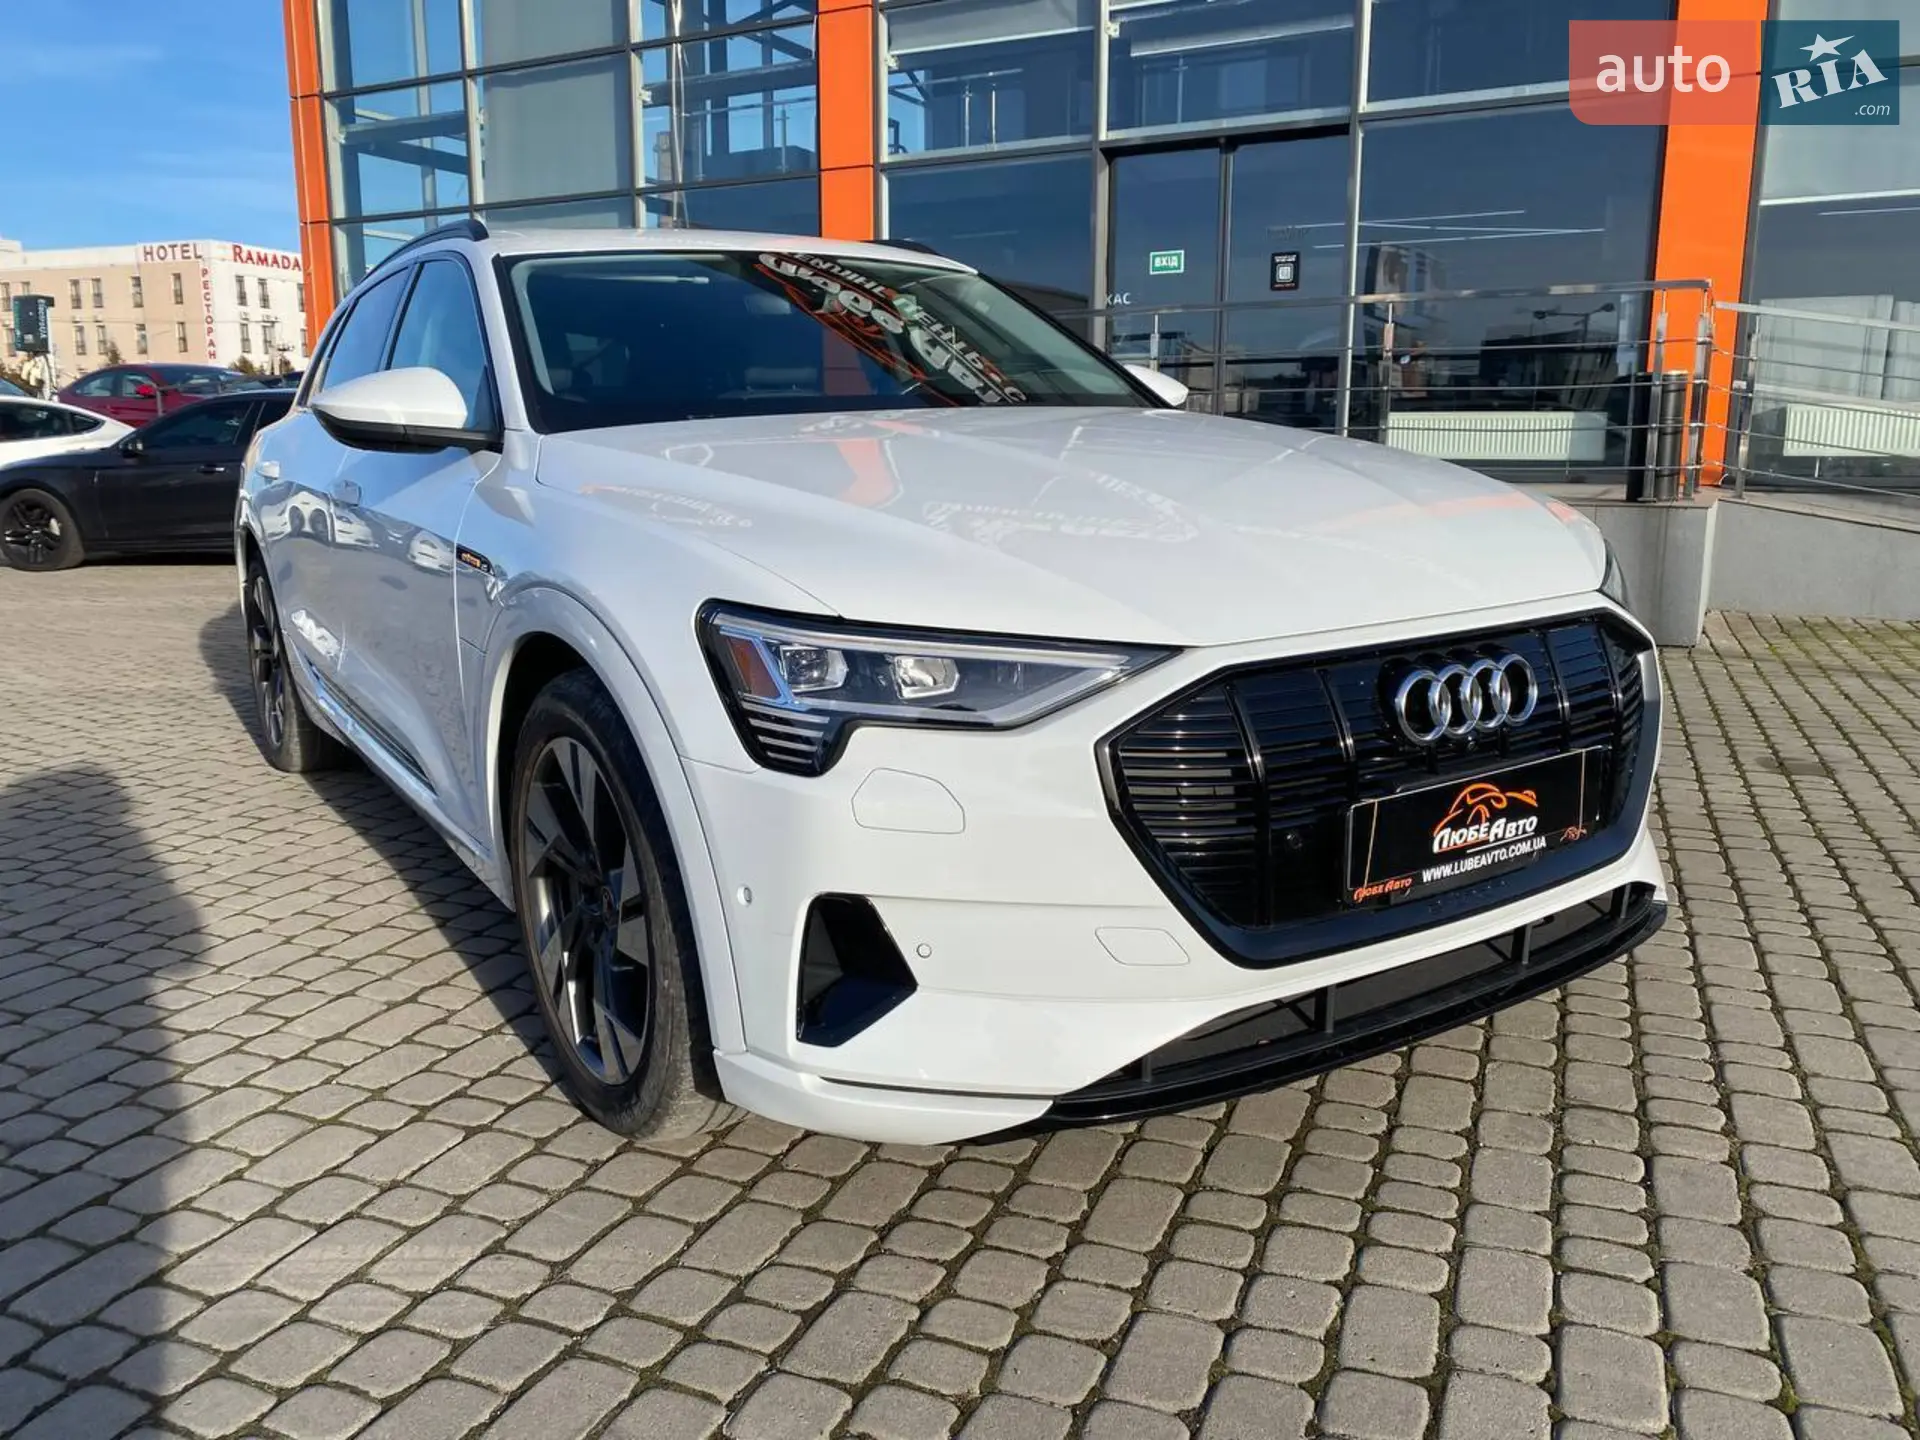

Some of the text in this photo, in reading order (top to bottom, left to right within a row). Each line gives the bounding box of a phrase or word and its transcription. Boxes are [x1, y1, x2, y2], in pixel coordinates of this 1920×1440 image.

[143, 243, 203, 261] HOTEL
[201, 268, 217, 360] РЕСТОРАН
[1422, 836, 1547, 883] WWW.LUBEAVTO.COM.UA
